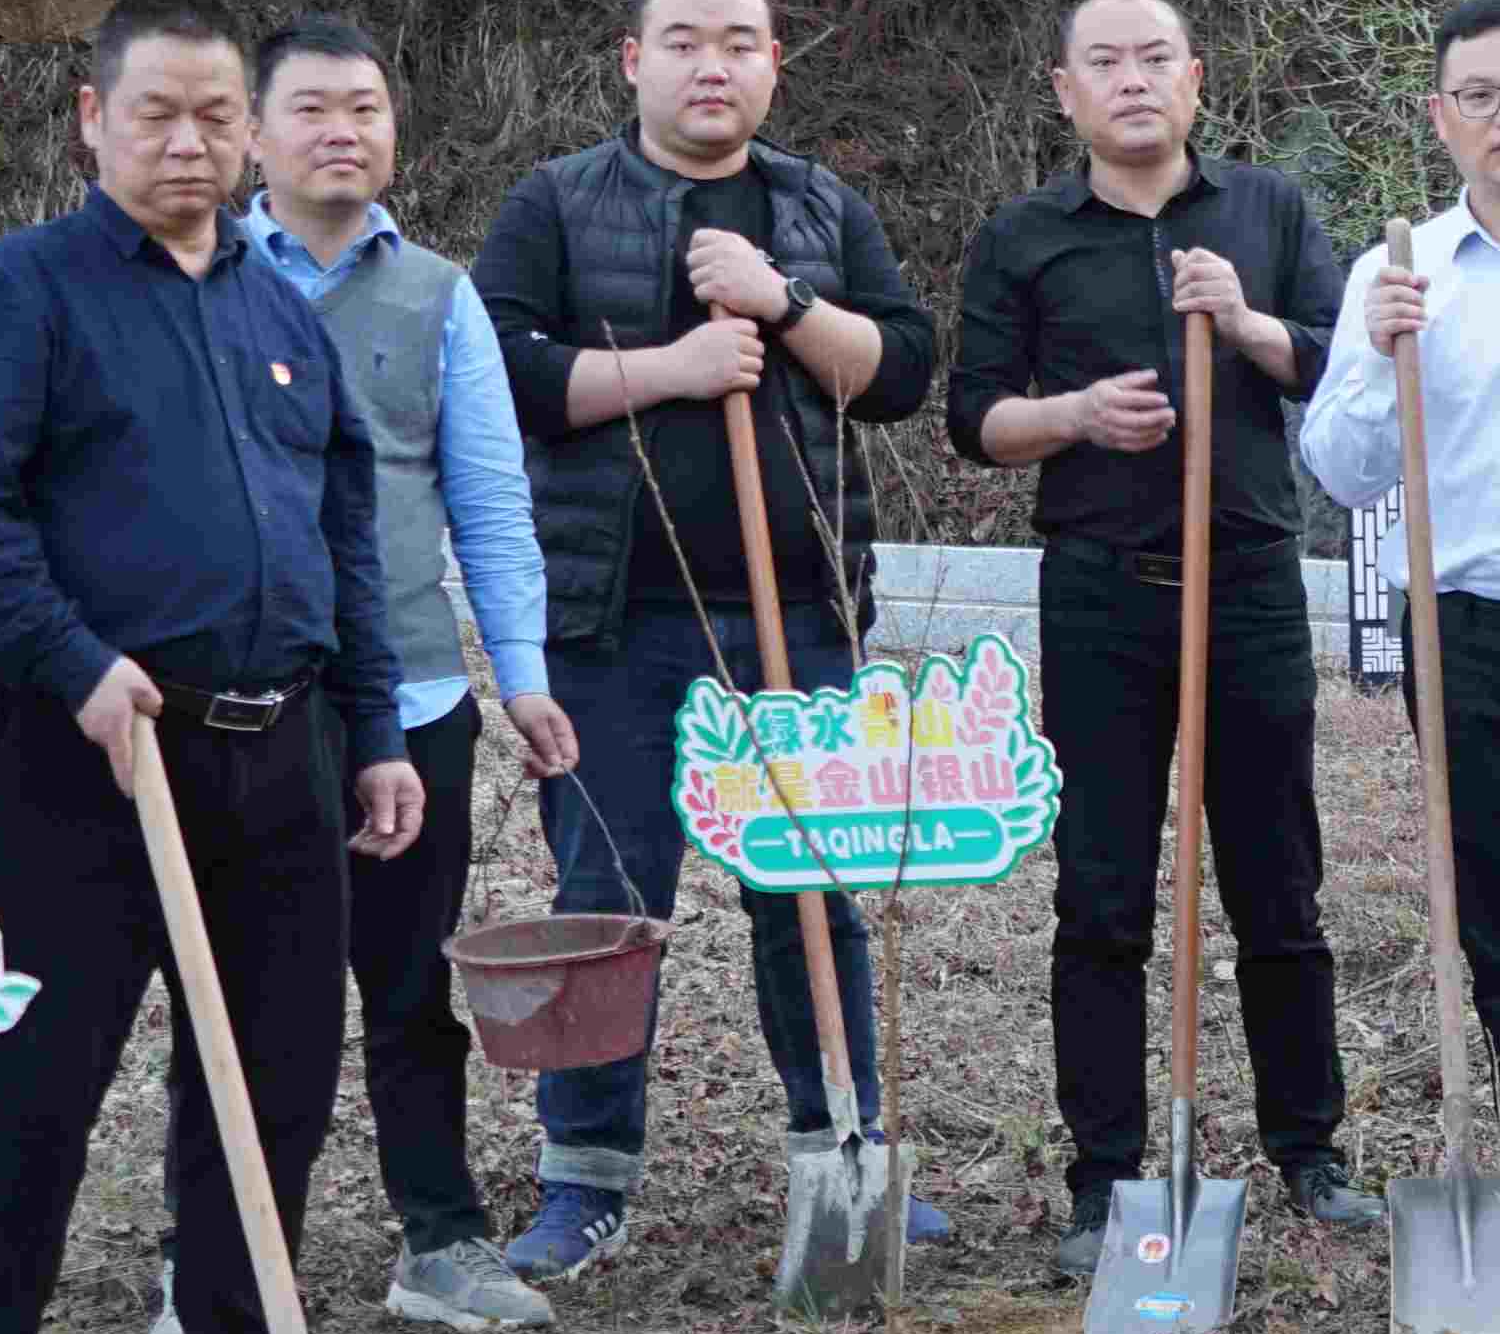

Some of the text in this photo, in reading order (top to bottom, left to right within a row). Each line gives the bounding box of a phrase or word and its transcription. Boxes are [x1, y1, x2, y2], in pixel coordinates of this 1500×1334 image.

[756, 697, 954, 755] 绿水青山
[712, 751, 1017, 812] 就是金山银山
